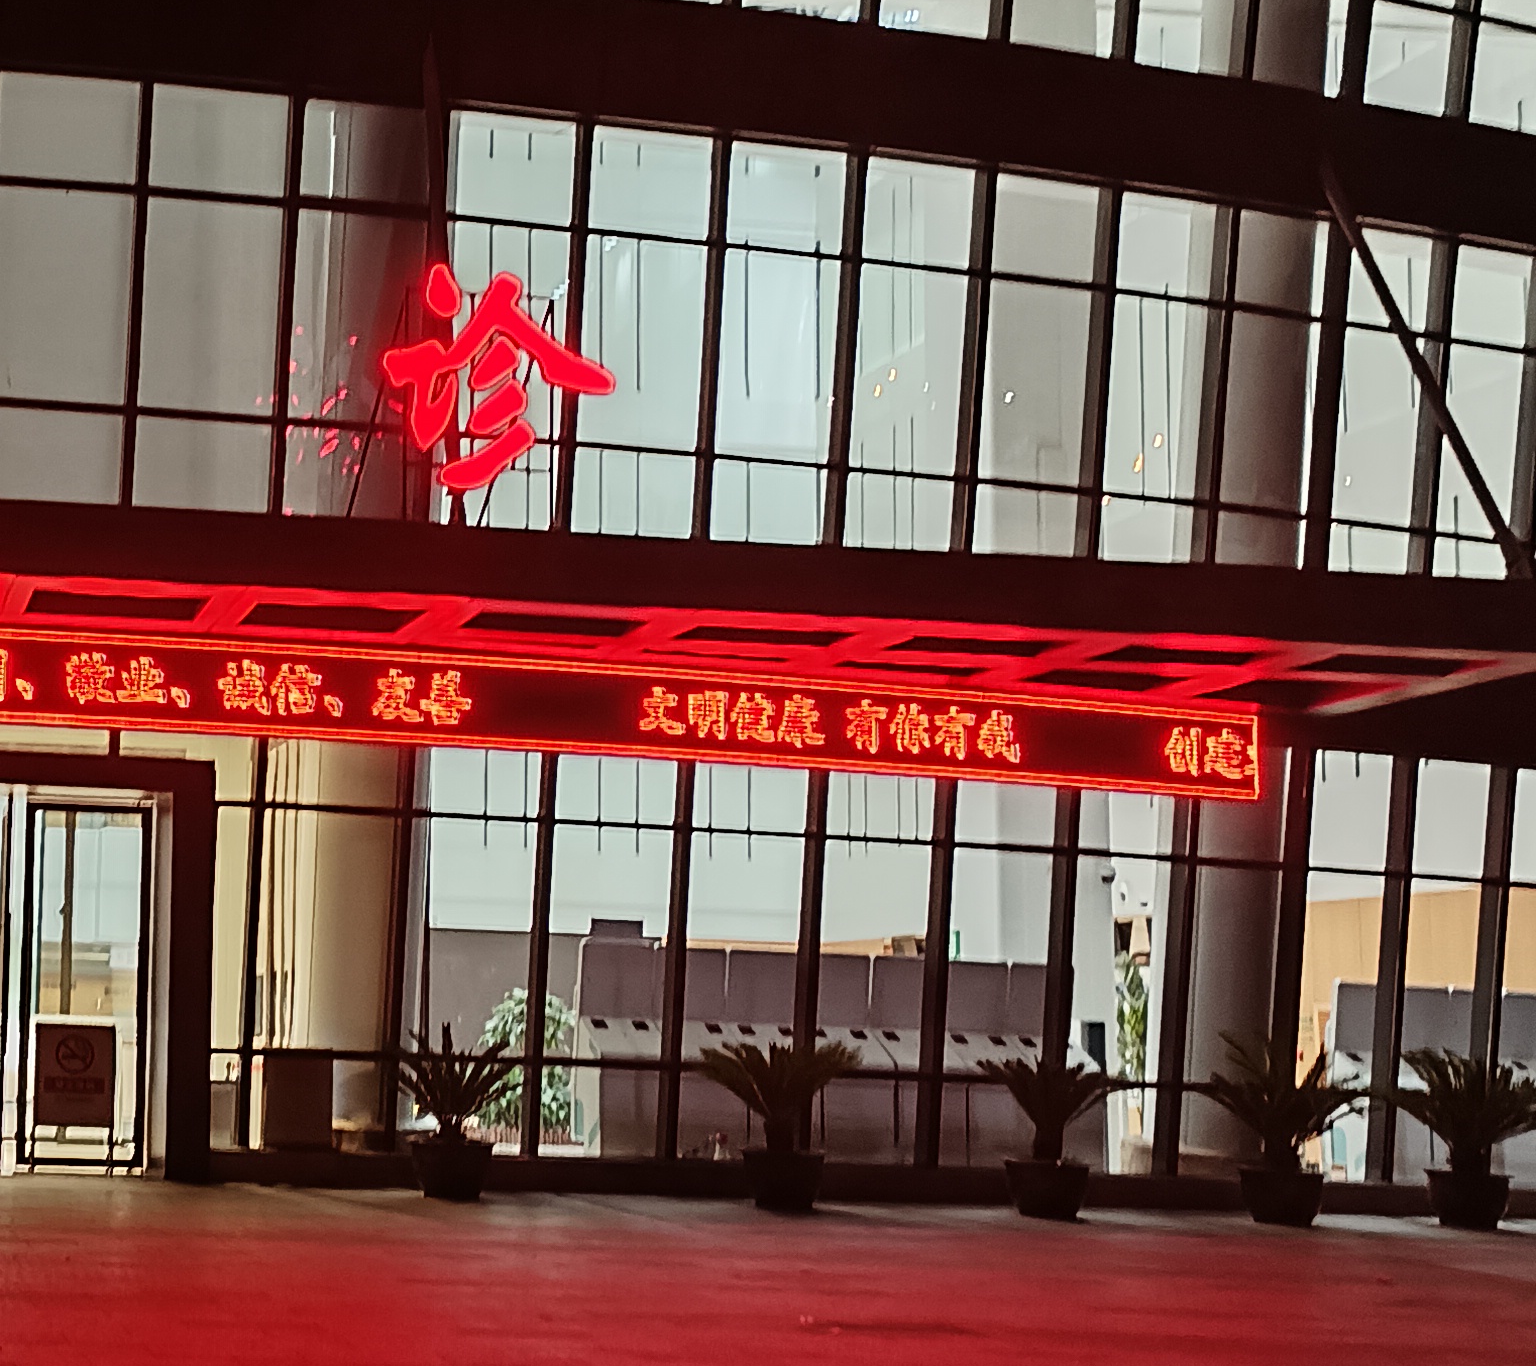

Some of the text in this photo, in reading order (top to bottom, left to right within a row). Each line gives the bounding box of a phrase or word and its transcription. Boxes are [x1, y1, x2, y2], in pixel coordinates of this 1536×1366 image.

[382, 263, 616, 489] 诊
[638, 686, 1021, 764] 文明健康 有你有我
[1163, 726, 1256, 780] 创建
